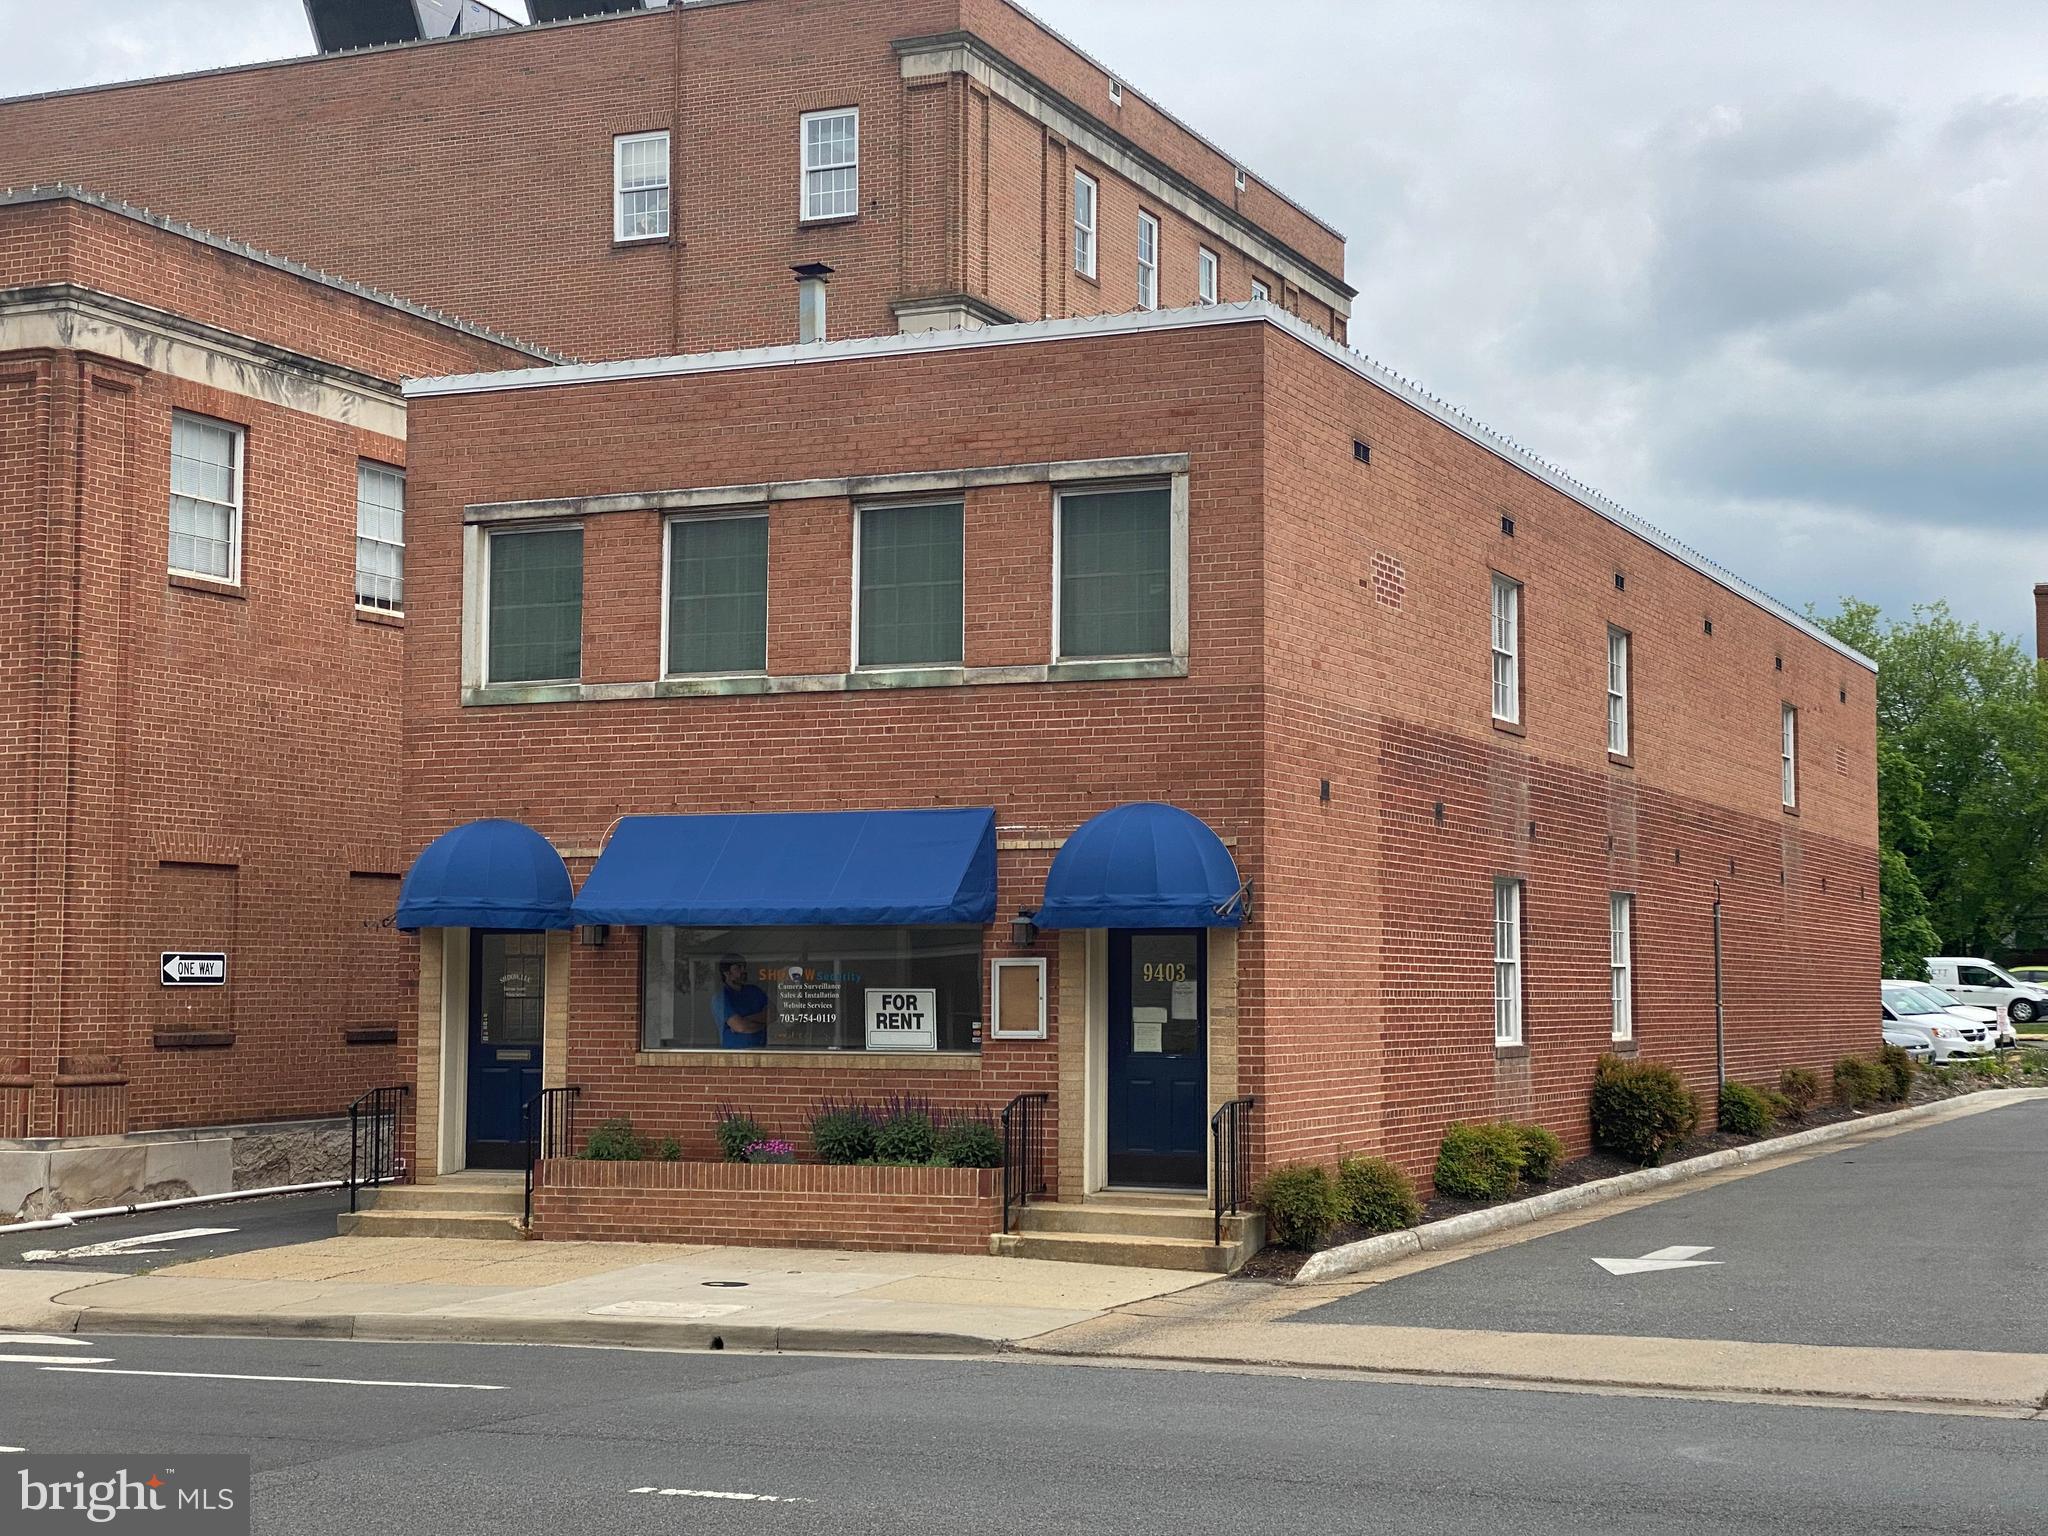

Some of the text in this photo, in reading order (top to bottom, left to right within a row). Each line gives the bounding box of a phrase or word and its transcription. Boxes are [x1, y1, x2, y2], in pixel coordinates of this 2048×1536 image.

[178, 962, 215, 975] ONE WAY
[1143, 963, 1186, 982] 9403
[882, 994, 918, 1011] FOR
[780, 1014, 837, 1023] 703-754-0119
[876, 1013, 925, 1030] RENT
